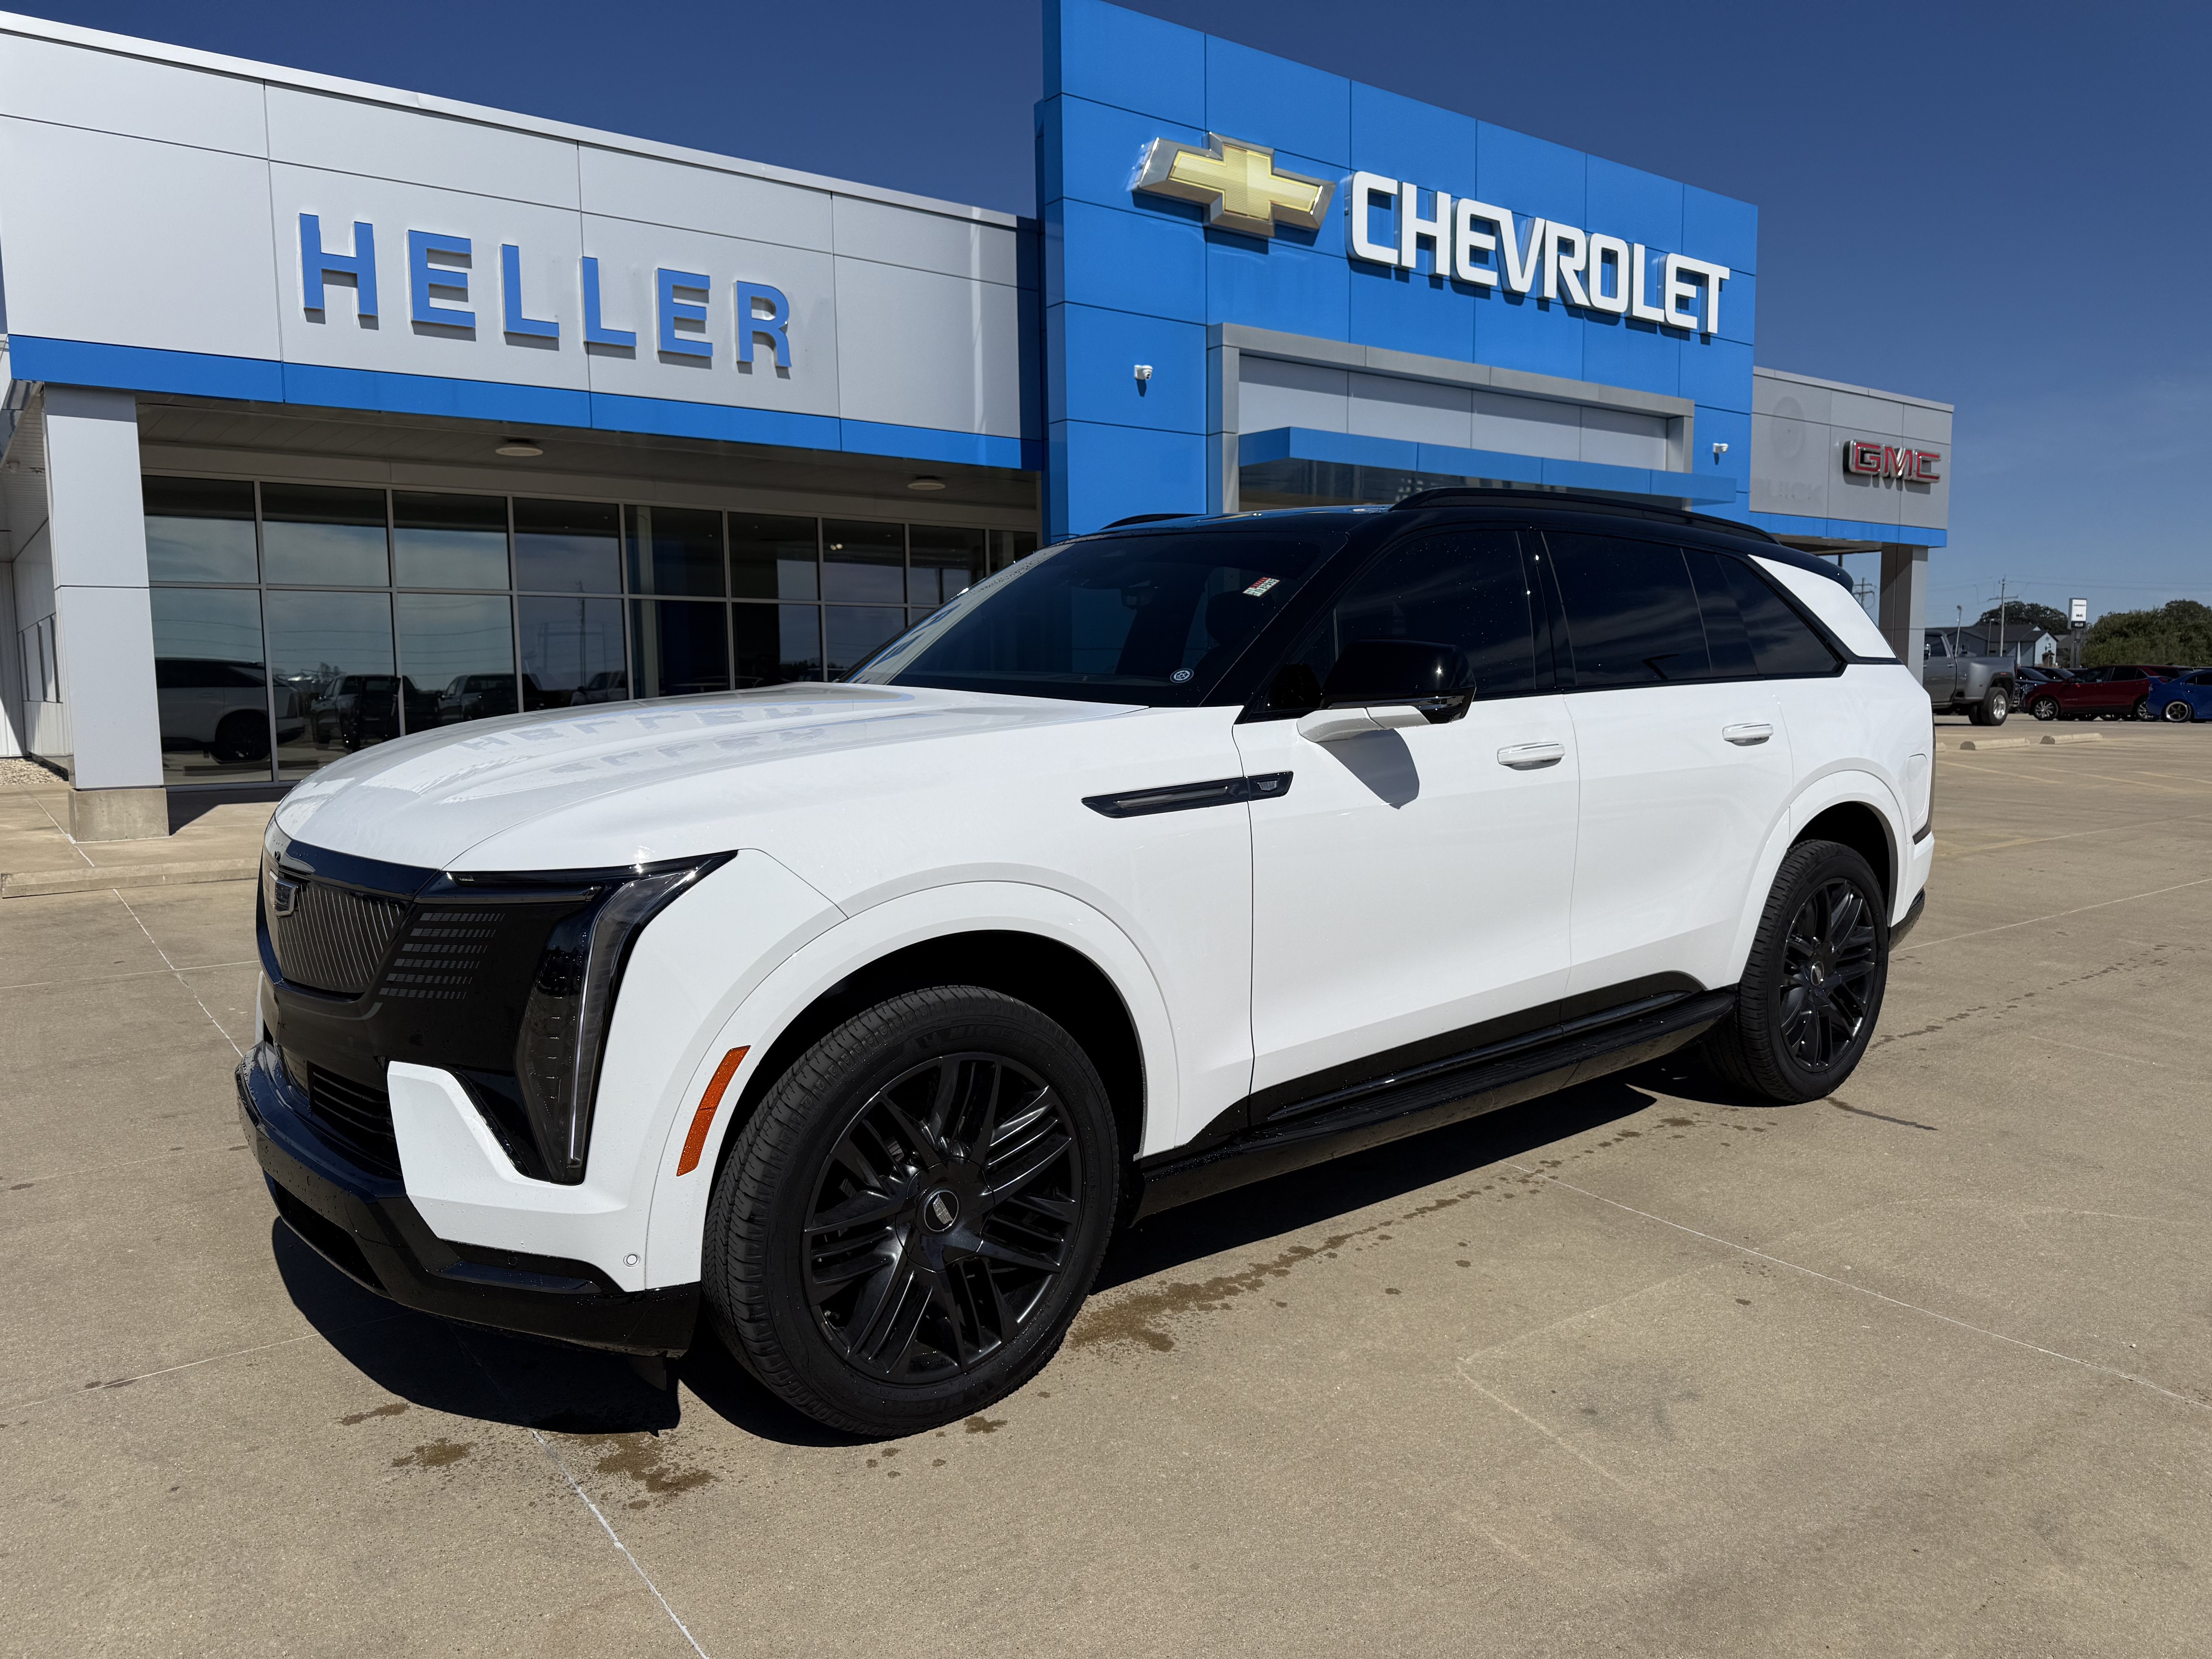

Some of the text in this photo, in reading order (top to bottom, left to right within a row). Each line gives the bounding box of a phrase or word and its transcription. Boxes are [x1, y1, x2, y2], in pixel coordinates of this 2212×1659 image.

[299, 213, 792, 369] HELLER
[1347, 170, 1729, 334] CHEVROLET
[1848, 439, 1941, 484] GMC
